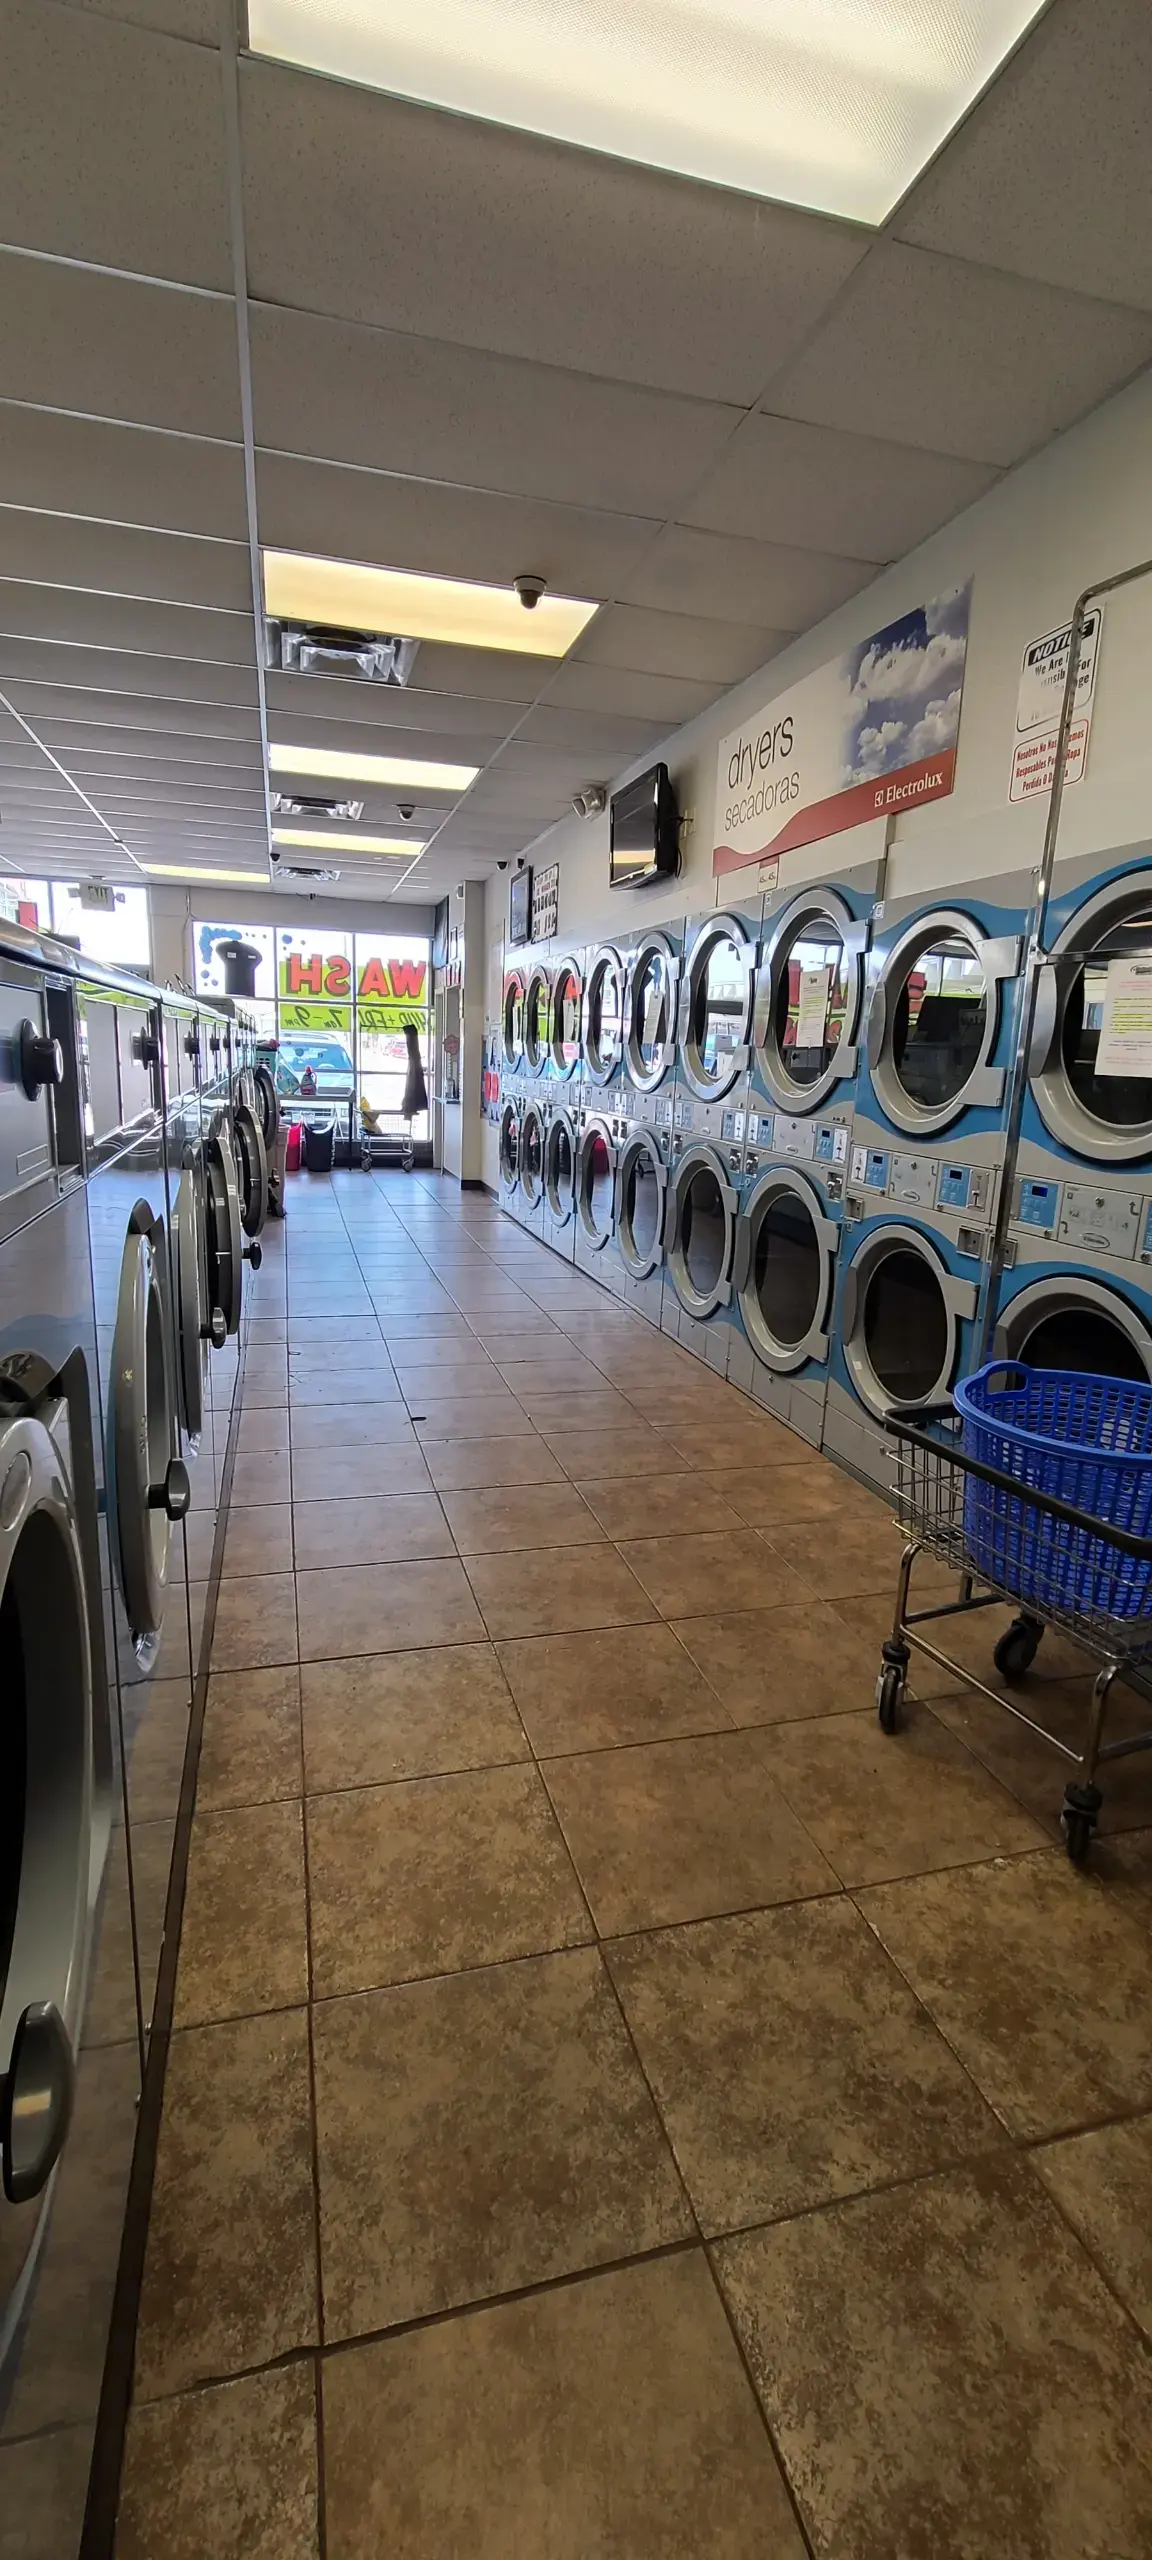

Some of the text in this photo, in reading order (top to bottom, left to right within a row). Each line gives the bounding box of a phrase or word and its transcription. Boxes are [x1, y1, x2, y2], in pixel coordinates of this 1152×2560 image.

[1033, 623, 1089, 663] NOTIE
[1048, 657, 1063, 671] Are
[728, 716, 794, 790] dryers
[1039, 743, 1046, 753] No
[886, 771, 943, 804] Electrolux
[1022, 776, 1042, 792] Perdida
[724, 771, 800, 832] secadoras
